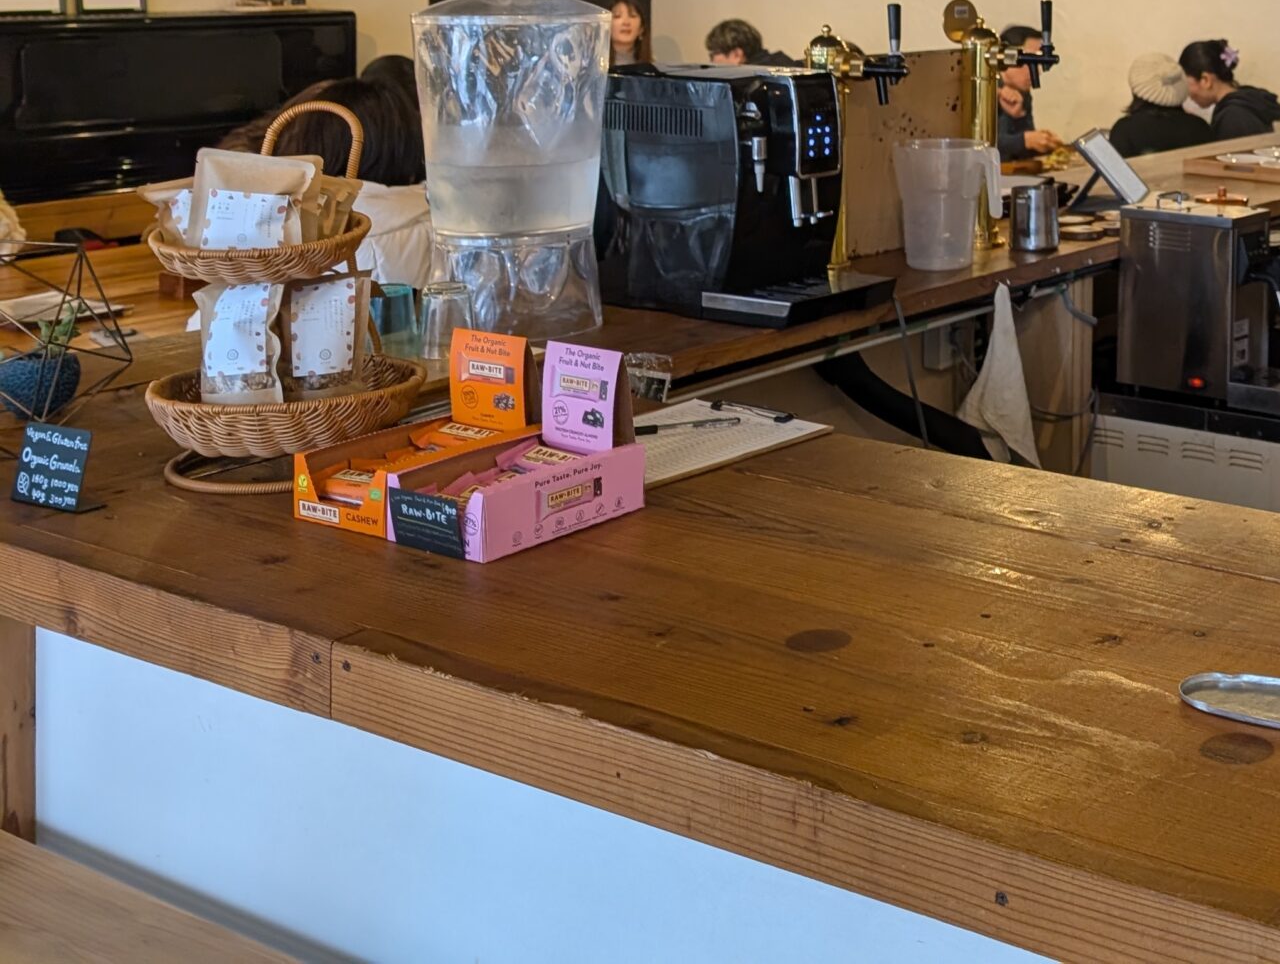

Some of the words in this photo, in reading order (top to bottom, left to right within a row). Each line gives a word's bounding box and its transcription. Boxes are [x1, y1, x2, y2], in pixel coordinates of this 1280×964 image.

[471, 334, 482, 343] The
[482, 336, 508, 347] Organic
[464, 343, 480, 353] Fruit
[565, 347, 576, 357] The
[576, 349, 601, 361] Organic
[559, 356, 573, 367] Fruit
[22, 446, 50, 469] Organic
[534, 479, 550, 488] Pure
[573, 466, 588, 475] Pure
[345, 512, 379, 526] CASHEW
